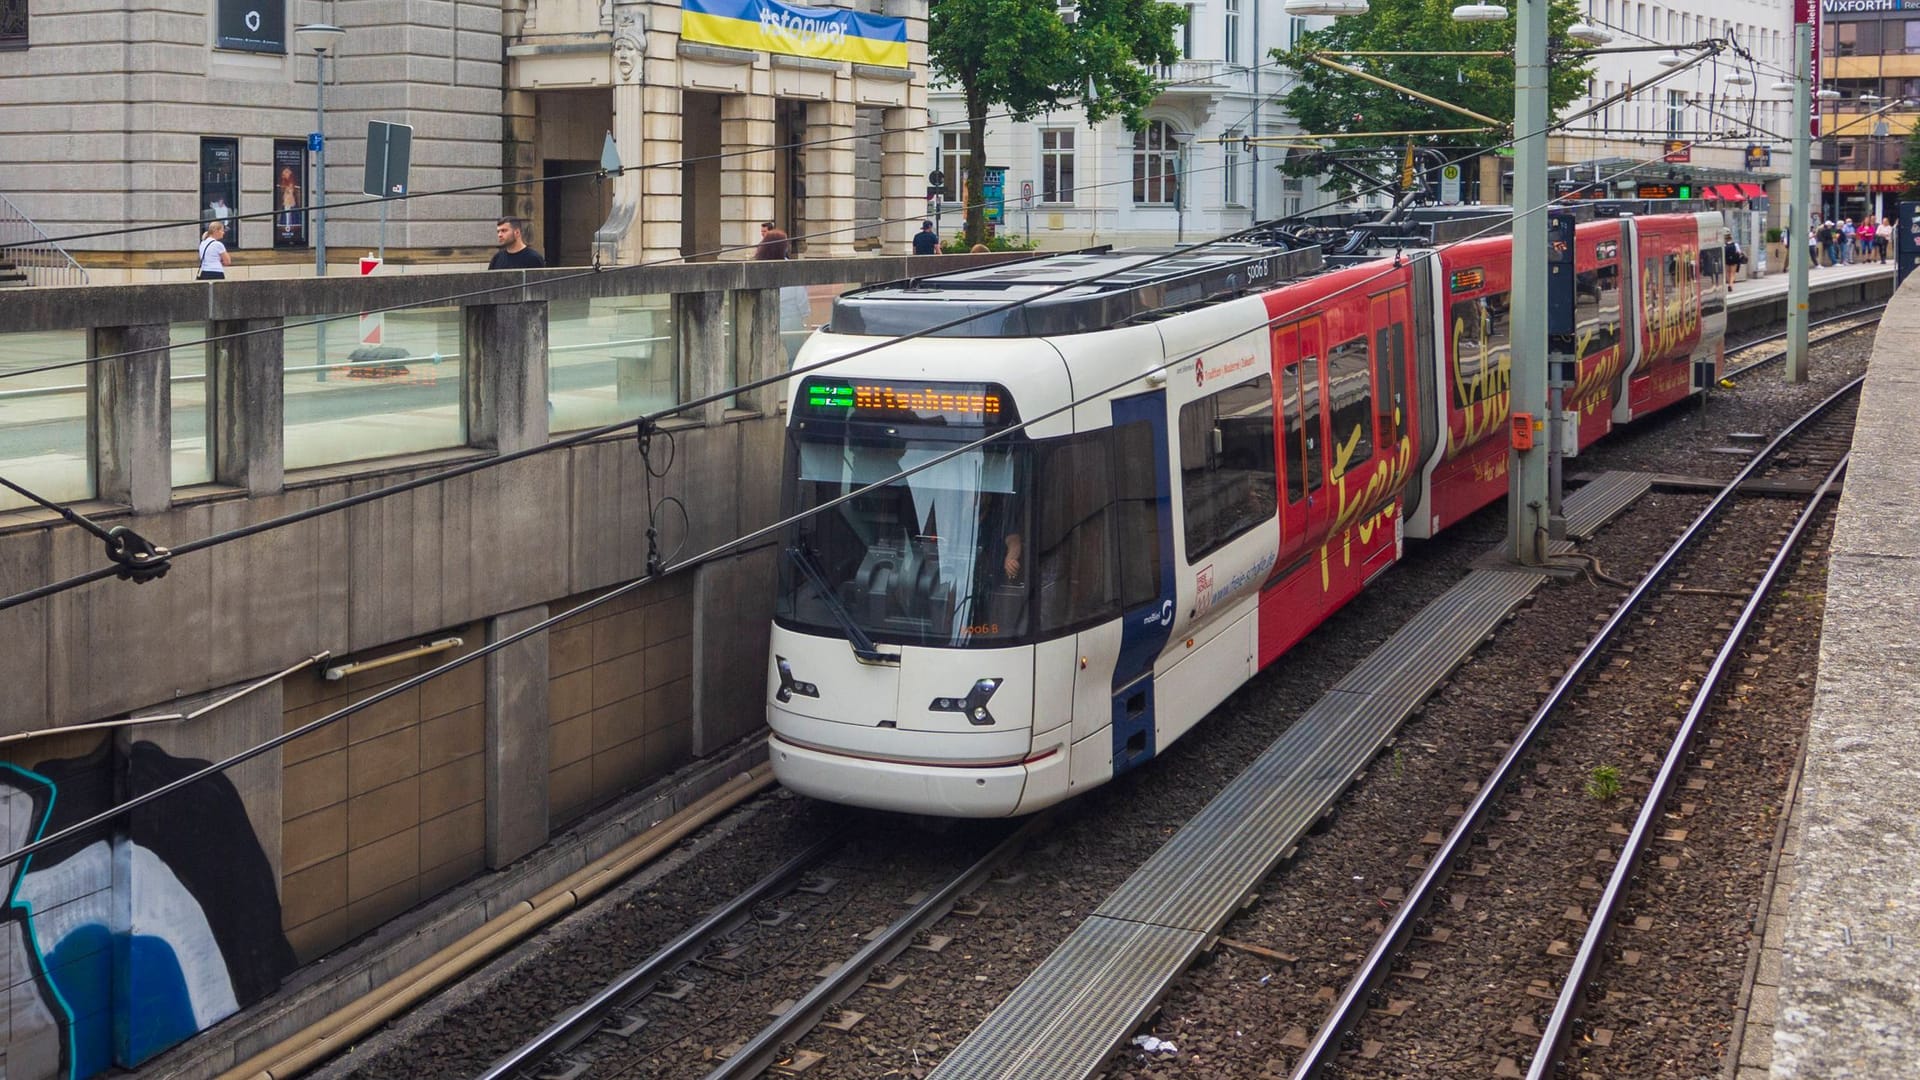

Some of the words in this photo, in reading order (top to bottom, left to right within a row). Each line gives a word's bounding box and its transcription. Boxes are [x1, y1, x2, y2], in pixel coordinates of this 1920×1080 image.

[760, 8, 848, 46] #stopwar
[1247, 259, 1263, 284] 5006
[1263, 258, 1269, 276] B
